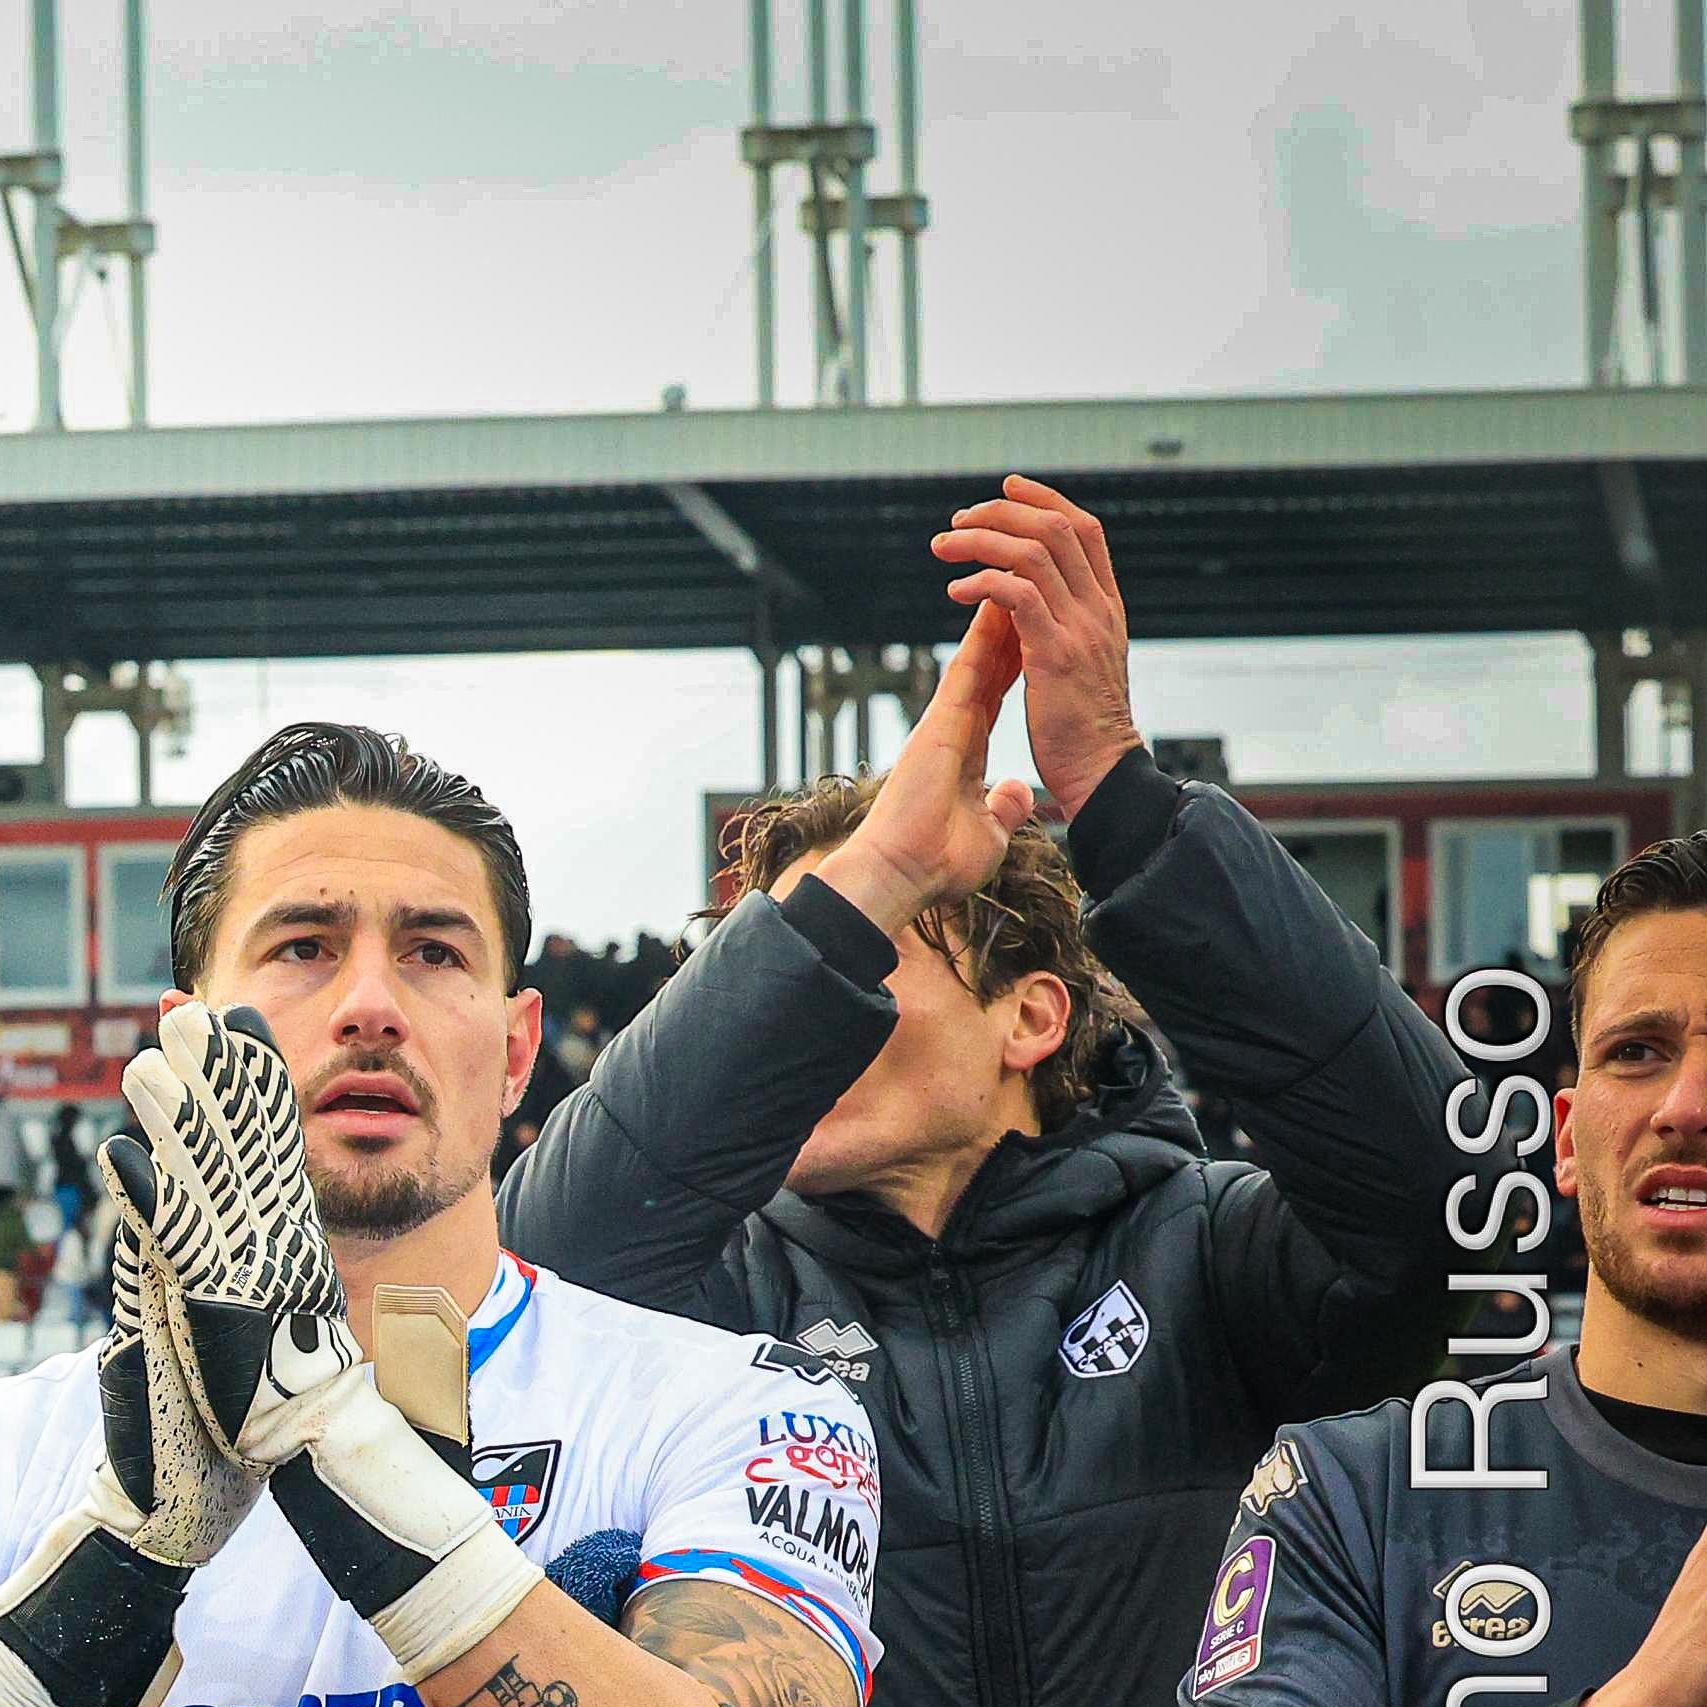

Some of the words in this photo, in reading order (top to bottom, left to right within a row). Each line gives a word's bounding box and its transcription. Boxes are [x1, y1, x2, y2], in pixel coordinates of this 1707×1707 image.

[1077, 1324, 1144, 1370] CATANIA
[758, 1531, 818, 1569] ACQUA
[1212, 1551, 1255, 1628] C
[1209, 1625, 1236, 1650] SERIE
[1198, 1666, 1216, 1684] sky
